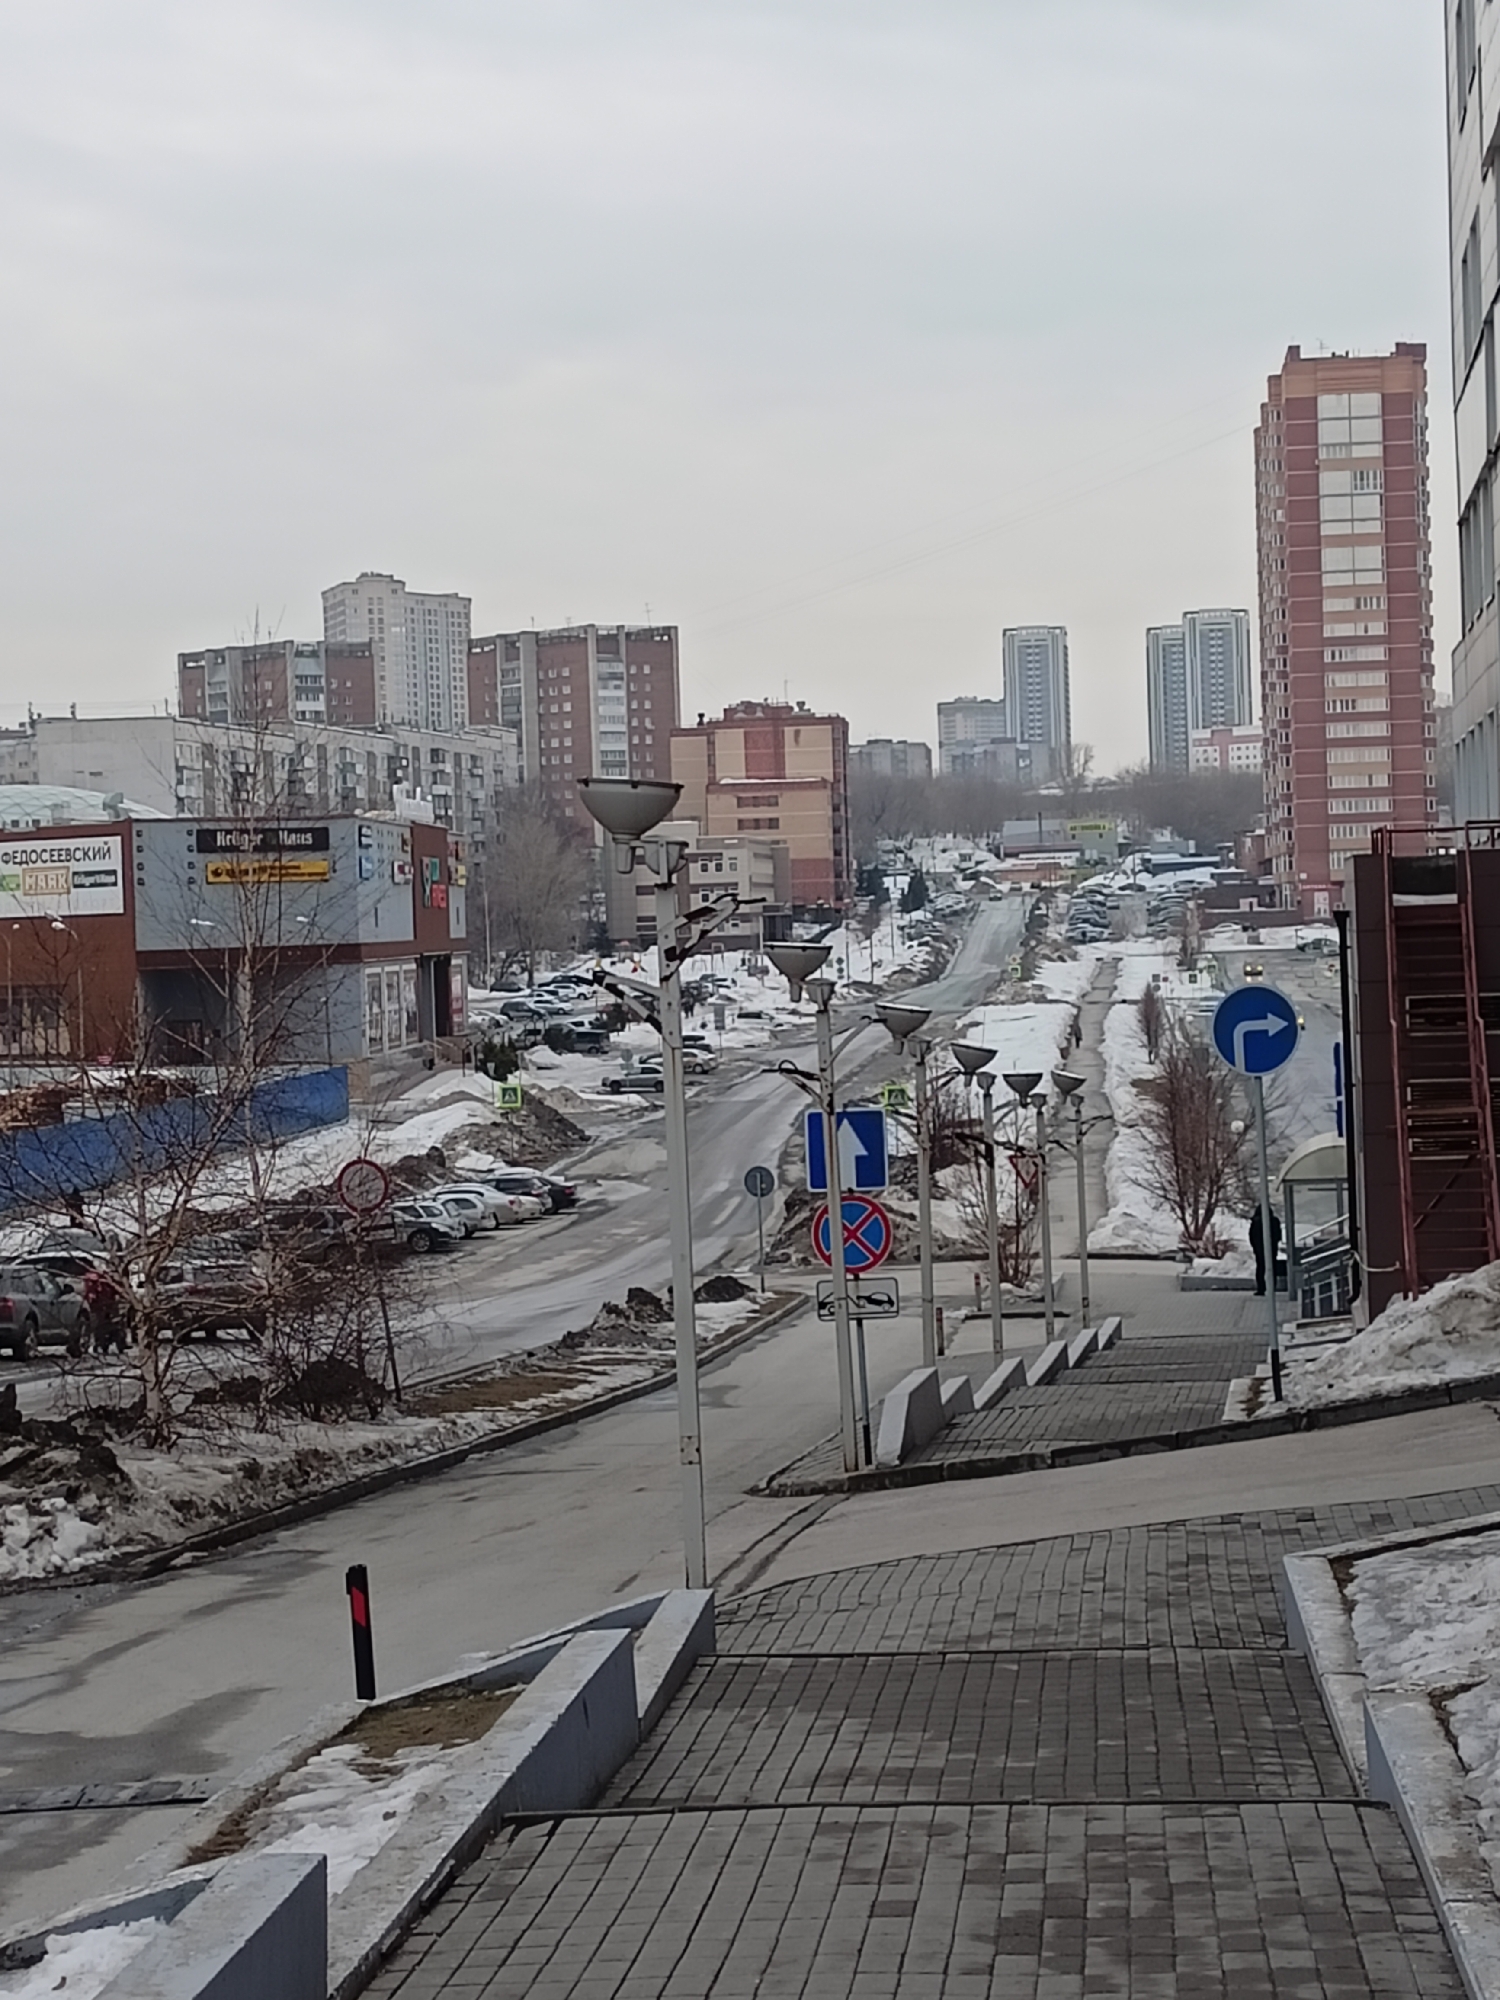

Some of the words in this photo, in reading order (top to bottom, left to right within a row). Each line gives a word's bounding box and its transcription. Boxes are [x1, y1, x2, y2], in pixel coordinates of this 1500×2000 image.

[278, 829, 314, 846] Haus
[1, 840, 112, 866] ФЕДОСЕЕВСКИЙ
[25, 873, 68, 891] МАЯК
